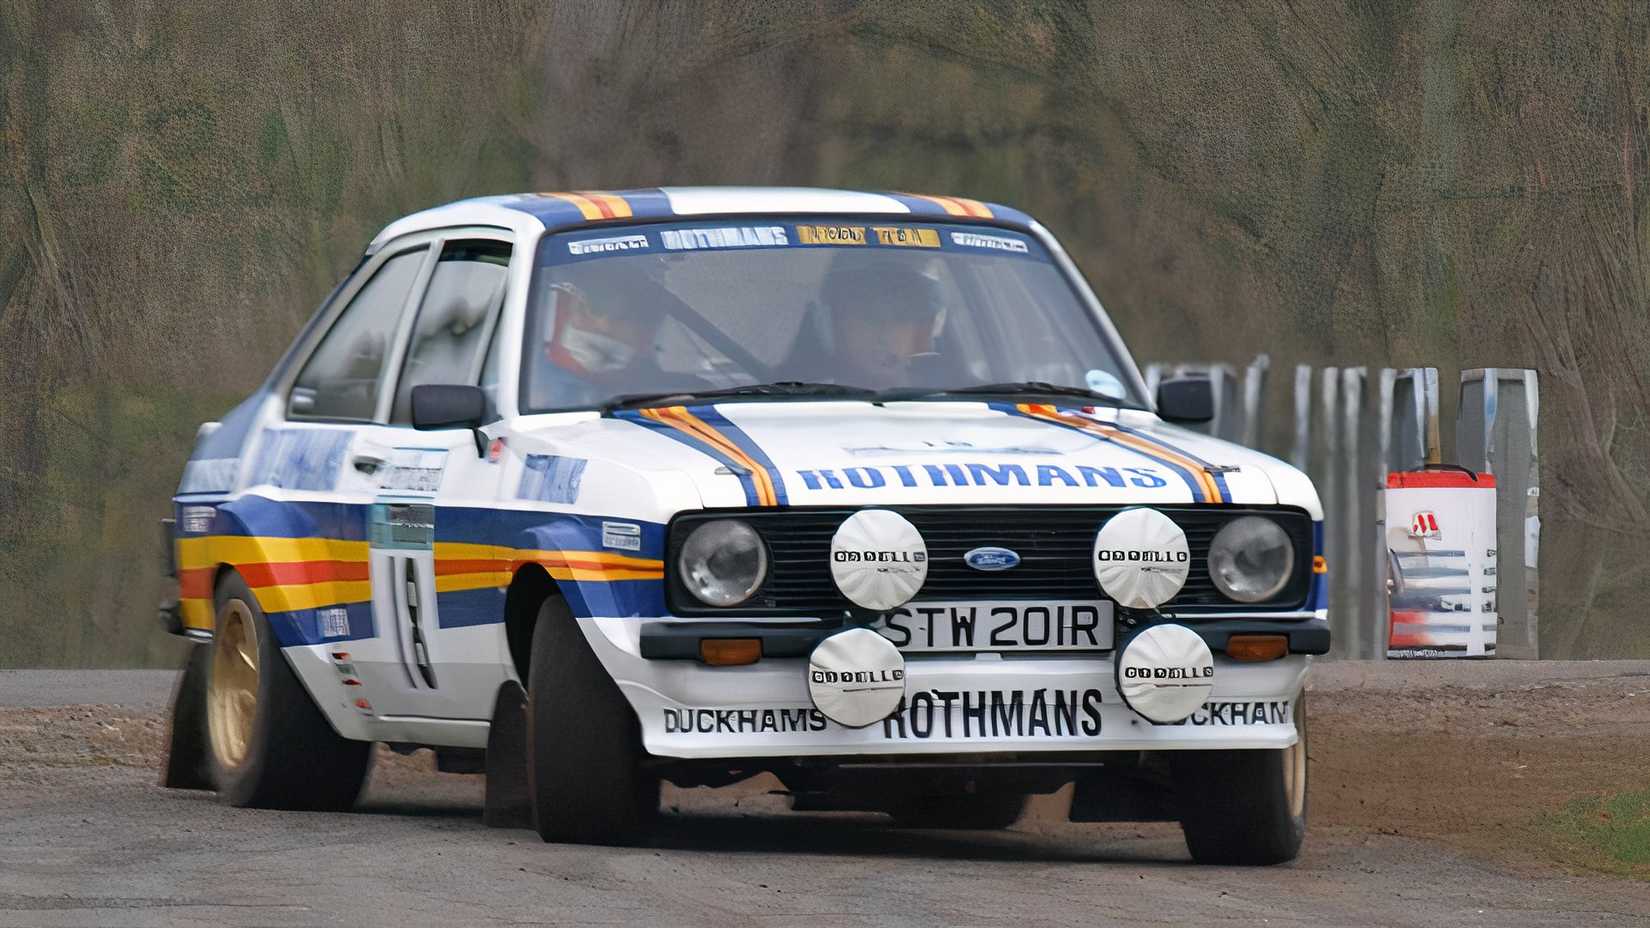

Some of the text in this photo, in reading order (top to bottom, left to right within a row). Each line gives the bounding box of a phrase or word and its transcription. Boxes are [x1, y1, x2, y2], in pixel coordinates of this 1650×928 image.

[797, 463, 1167, 490] ROTHMANS
[884, 606, 1099, 647] STW 201R
[663, 708, 827, 733] DUCKHAMS
